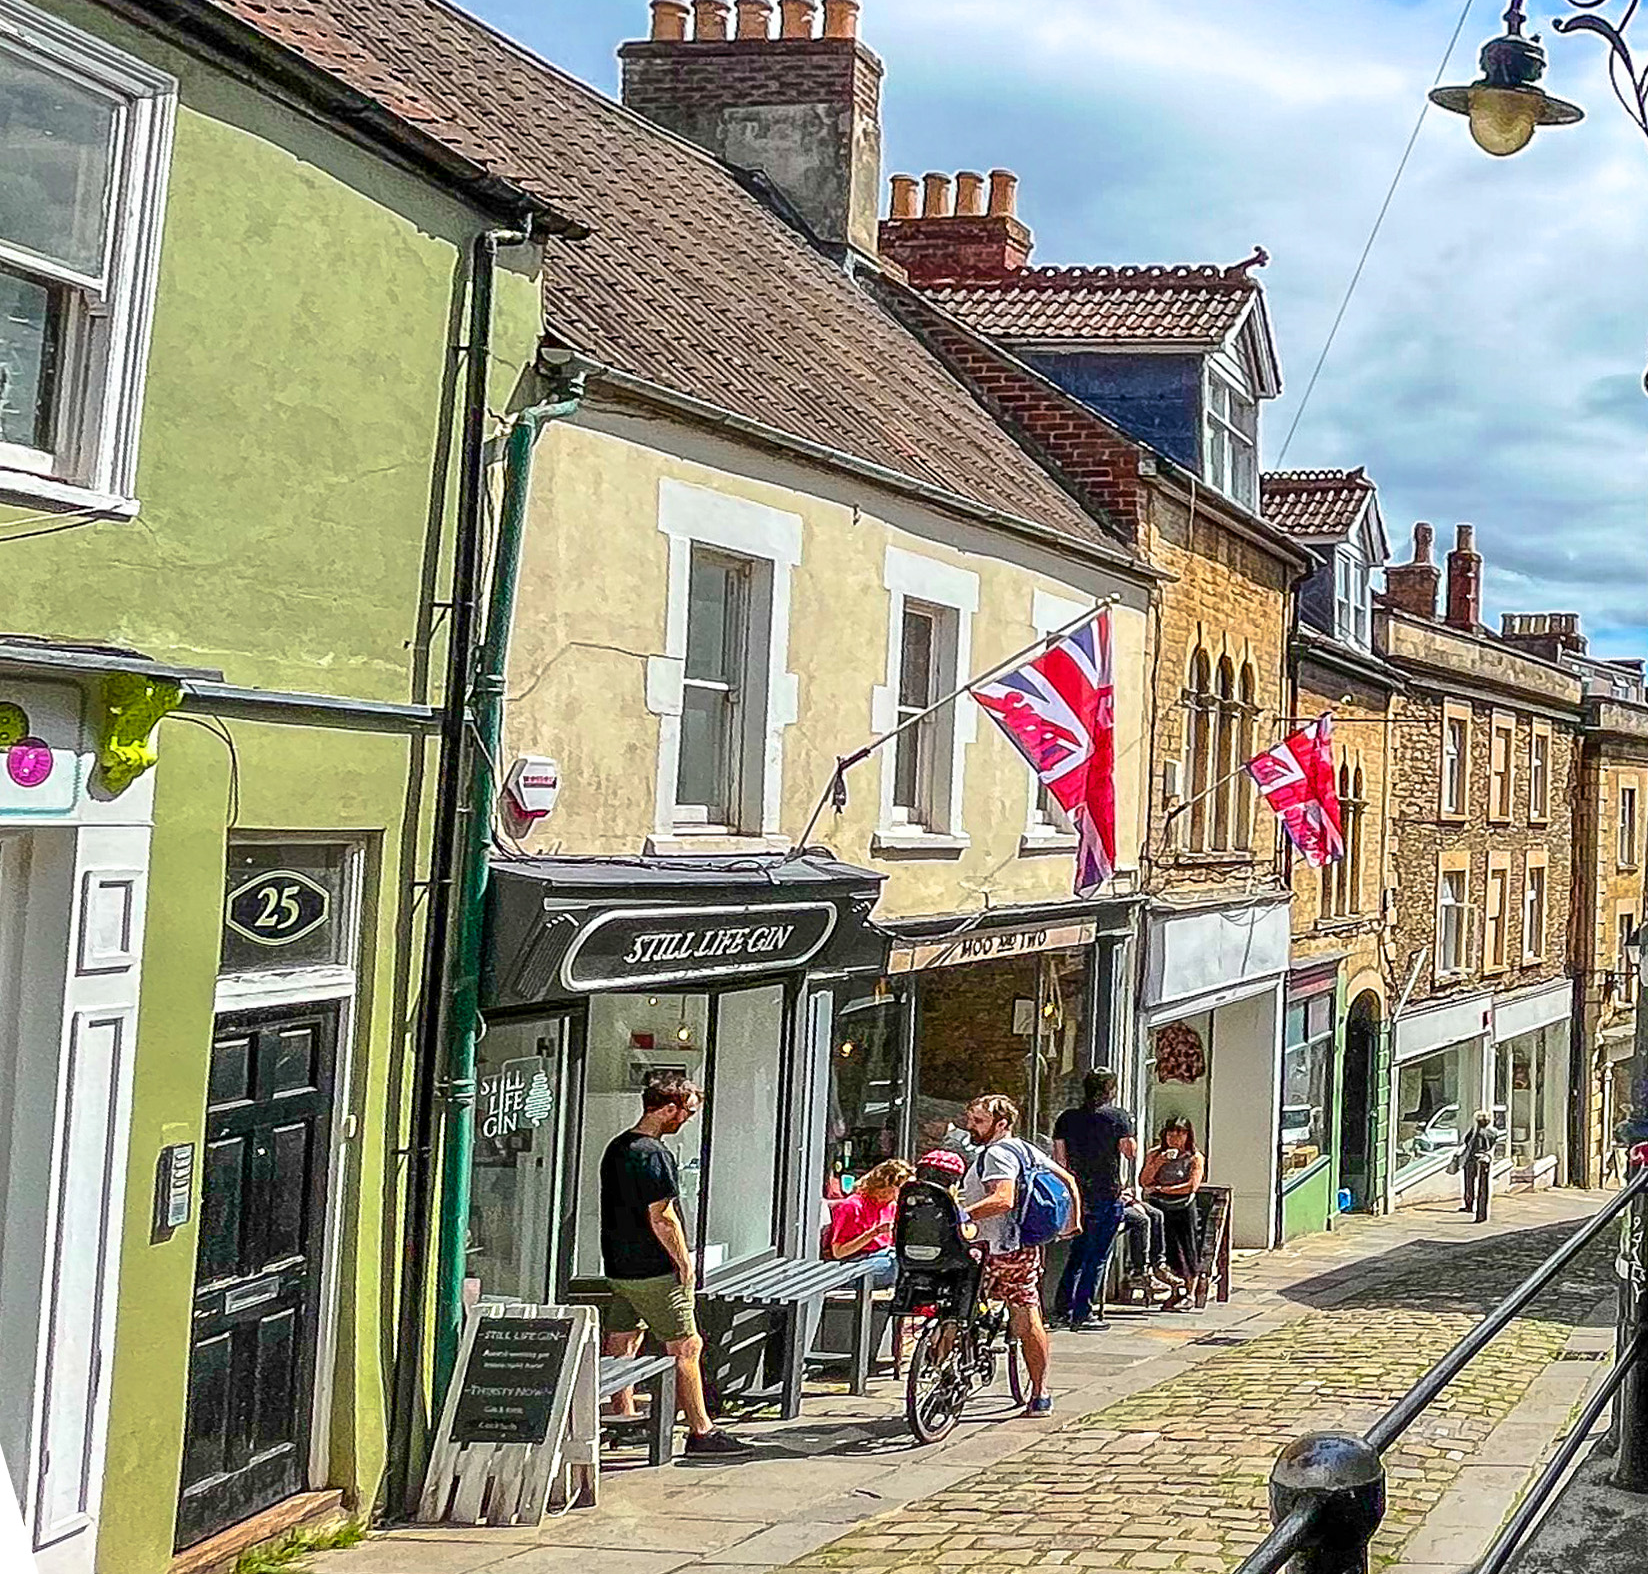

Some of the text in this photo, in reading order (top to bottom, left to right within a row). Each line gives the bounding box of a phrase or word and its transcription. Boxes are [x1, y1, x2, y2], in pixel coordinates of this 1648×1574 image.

[255, 886, 301, 929] 25
[623, 924, 795, 964] STILL LIFE GIN
[480, 1070, 525, 1096] STILL
[489, 1090, 524, 1115] LIFE
[482, 1112, 518, 1138] GIN
